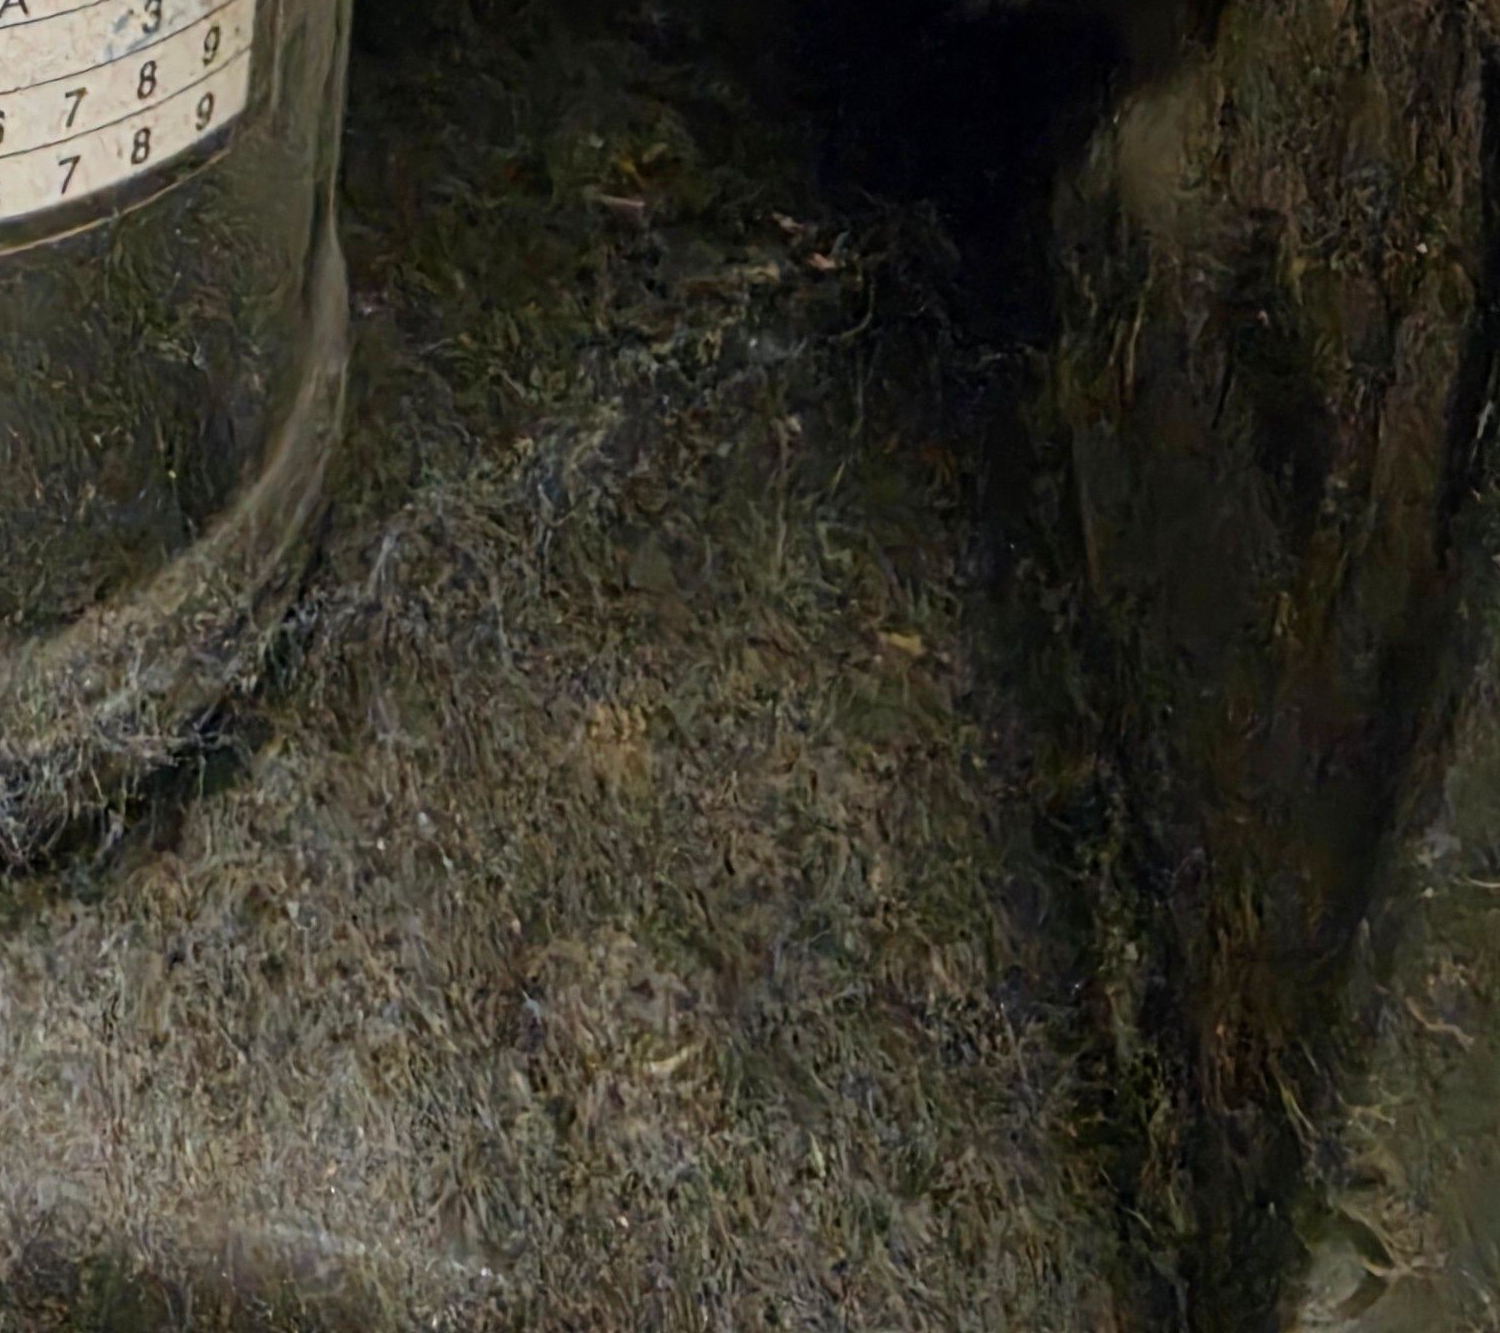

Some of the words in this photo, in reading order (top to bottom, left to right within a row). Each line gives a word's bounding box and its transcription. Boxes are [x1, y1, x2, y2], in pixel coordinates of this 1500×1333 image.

[64, 87, 89, 128] 7
[136, 60, 158, 99] 8
[203, 25, 221, 67] 9
[57, 155, 82, 196] 7
[130, 127, 151, 165] 8
[195, 91, 215, 131] 9
